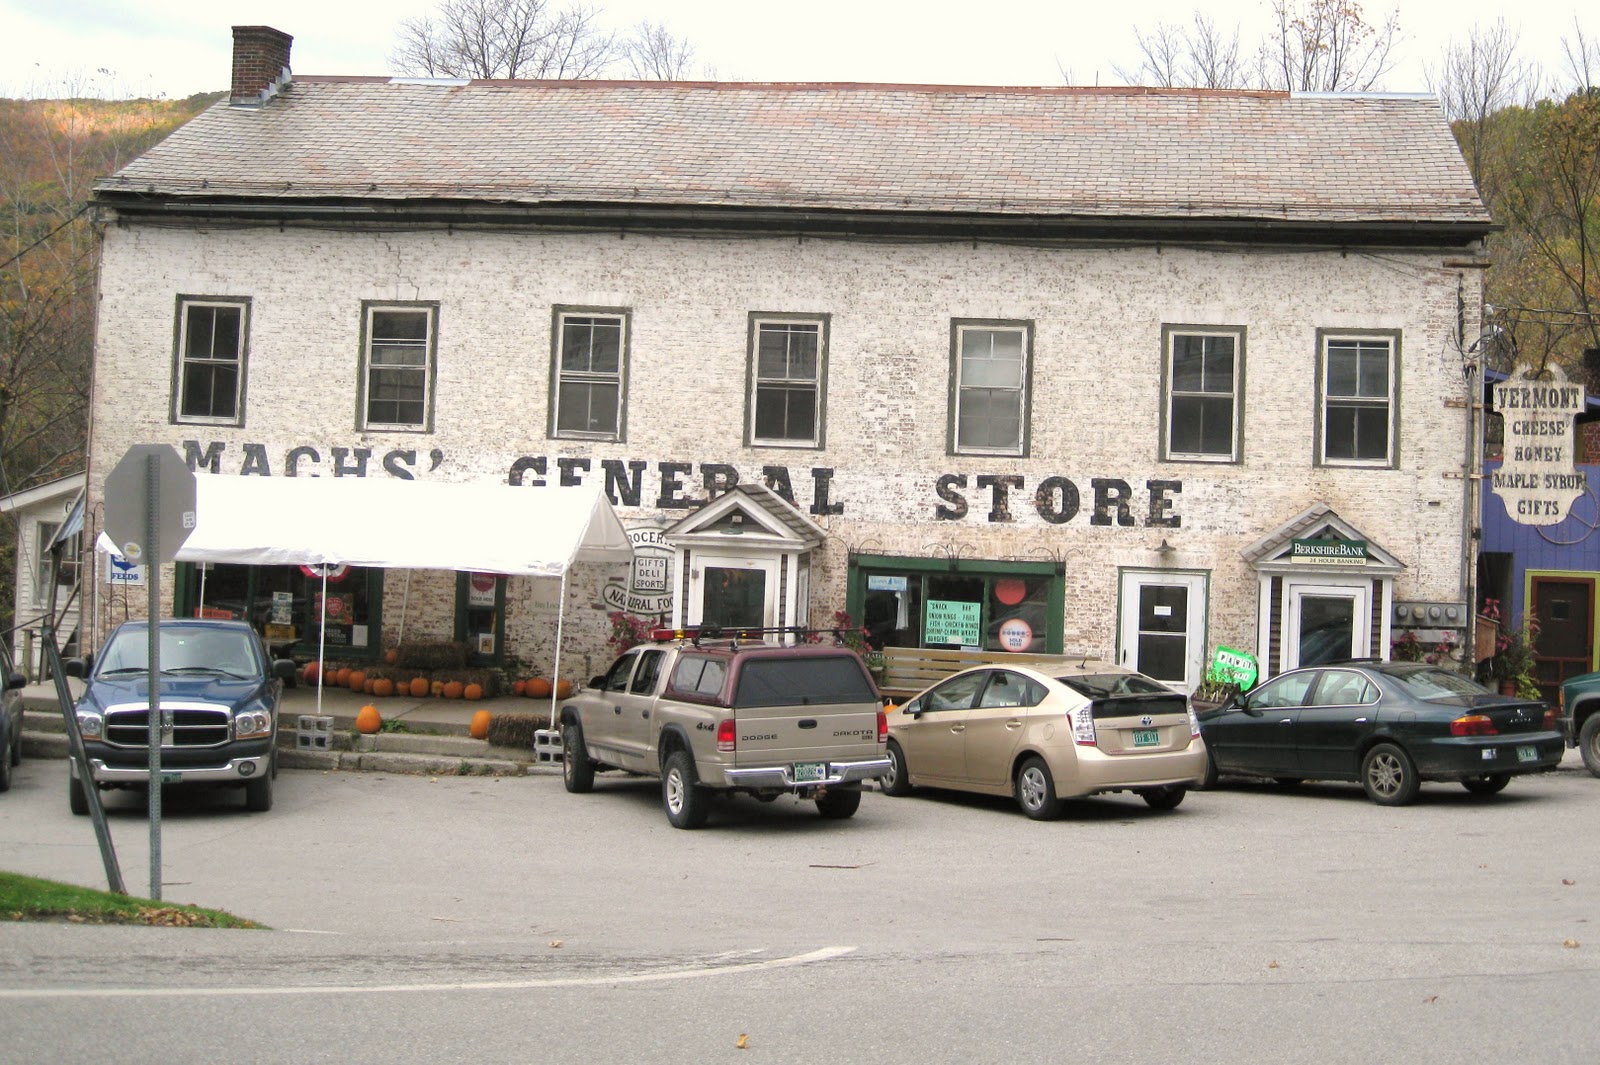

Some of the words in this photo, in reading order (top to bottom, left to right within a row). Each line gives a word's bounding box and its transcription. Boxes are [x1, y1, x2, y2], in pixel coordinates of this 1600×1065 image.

[1498, 387, 1579, 409] VERMONT
[1512, 420, 1565, 436] CHEESE
[1515, 446, 1562, 461] HONEY
[1494, 474, 1538, 489] MAPLE
[1545, 474, 1584, 490] SYRUP
[508, 456, 844, 515] GENERAL
[935, 474, 1182, 528] STORE
[1517, 500, 1559, 515] GIFTS
[628, 532, 676, 547] ROCER
[638, 559, 664, 567] GIFTS
[112, 572, 139, 581] FEEDS
[636, 580, 664, 588] SPORTS
[696, 722, 715, 732] 4x4
